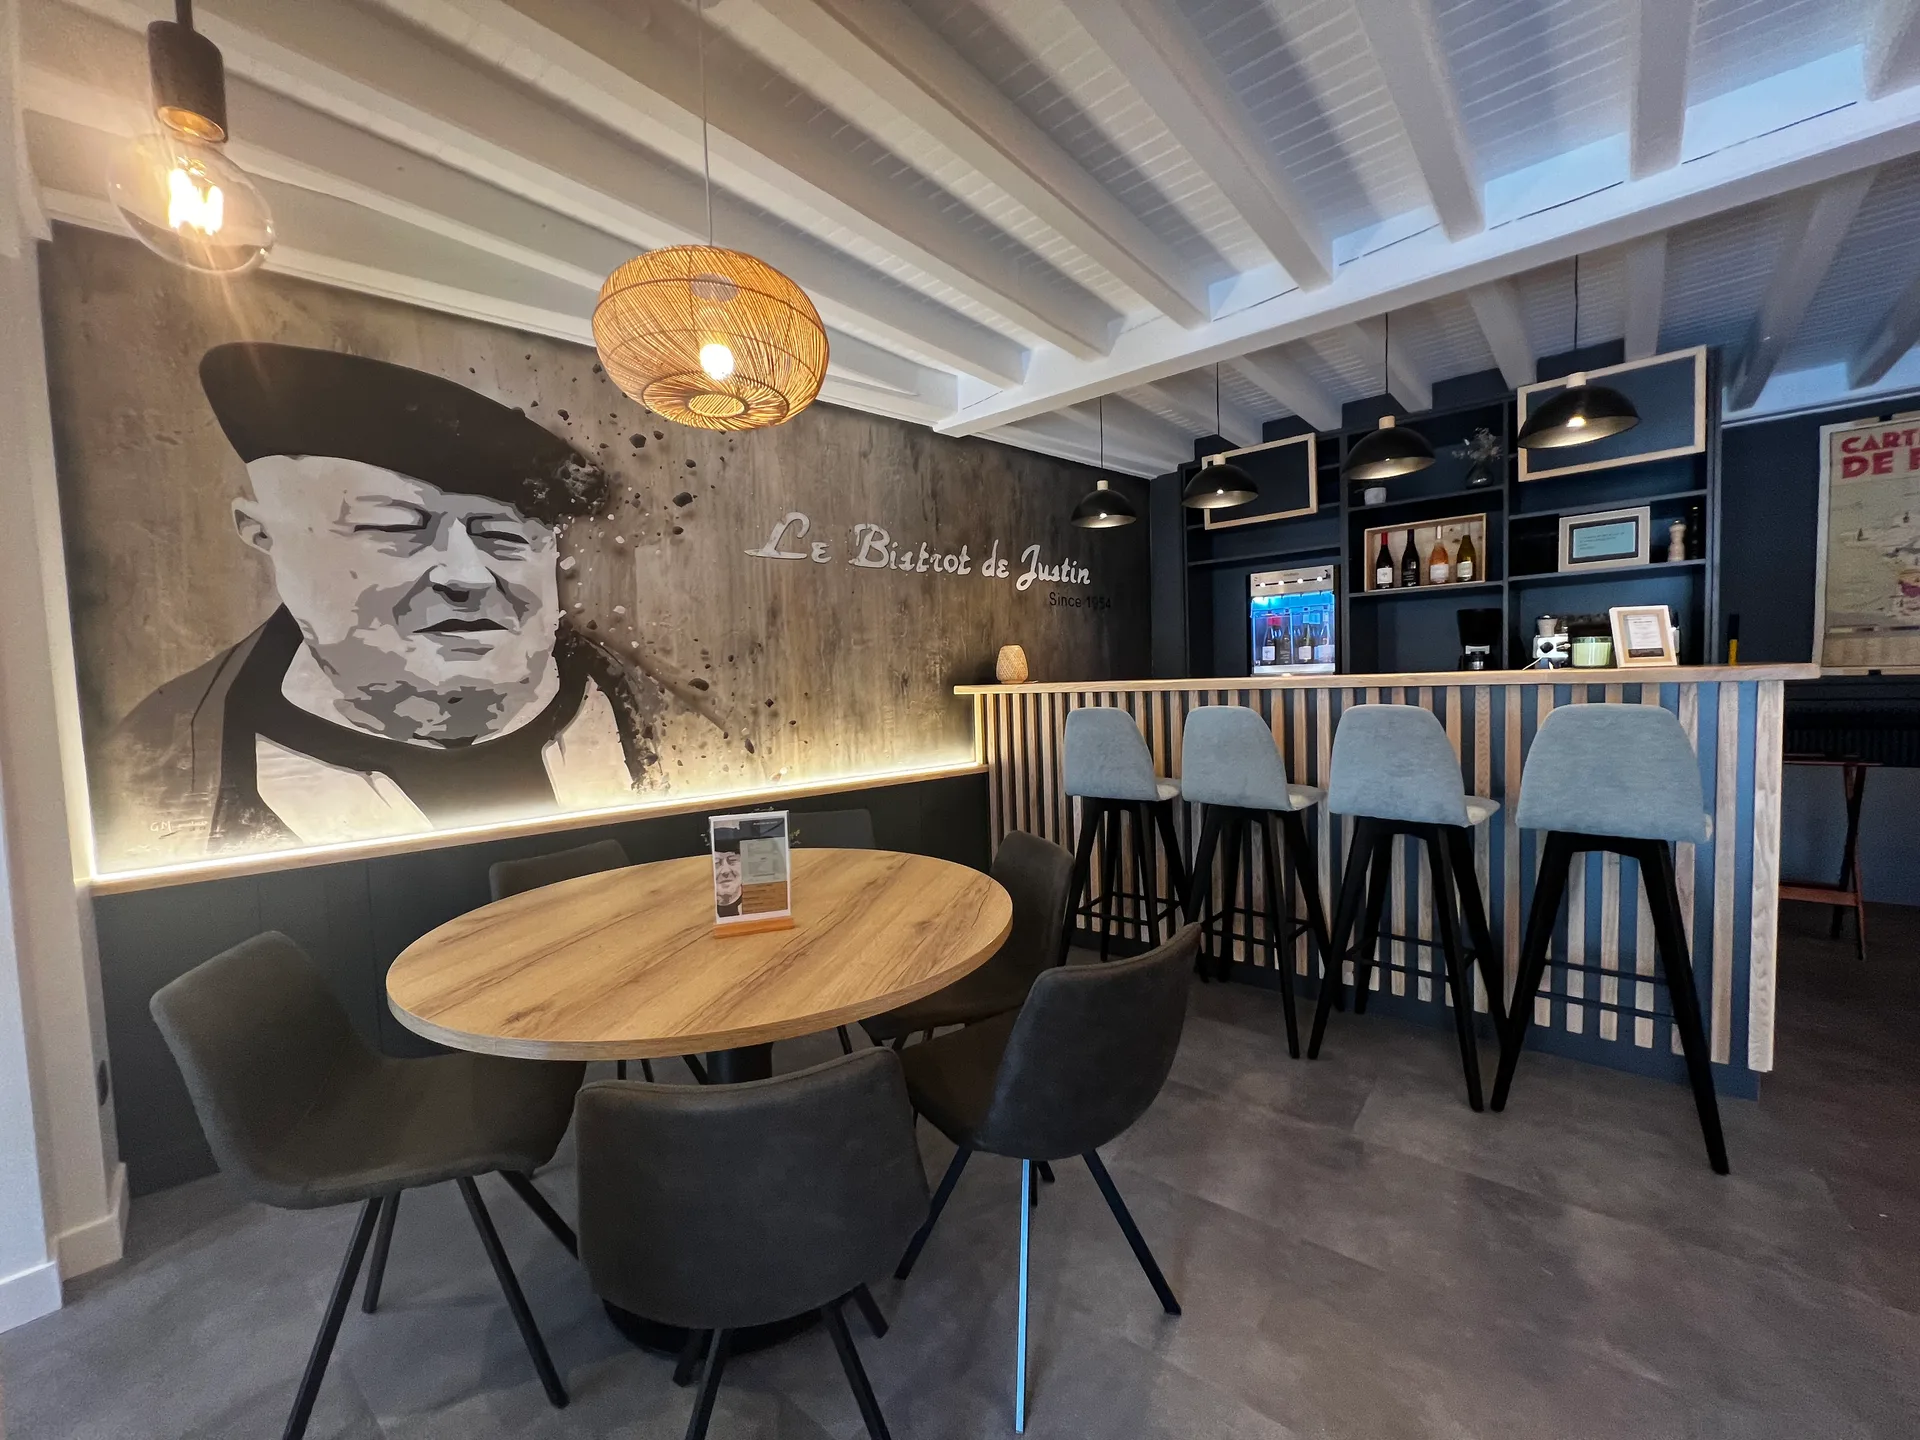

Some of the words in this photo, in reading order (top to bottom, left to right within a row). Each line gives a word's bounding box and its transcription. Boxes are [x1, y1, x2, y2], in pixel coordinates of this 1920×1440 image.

[1841, 428, 1920, 454] CART
[1842, 451, 1894, 479] DE
[744, 512, 832, 564] Le
[849, 523, 972, 576] Bistrot
[982, 538, 1010, 578] de
[1016, 544, 1091, 592] Justin
[1049, 591, 1082, 608] Since
